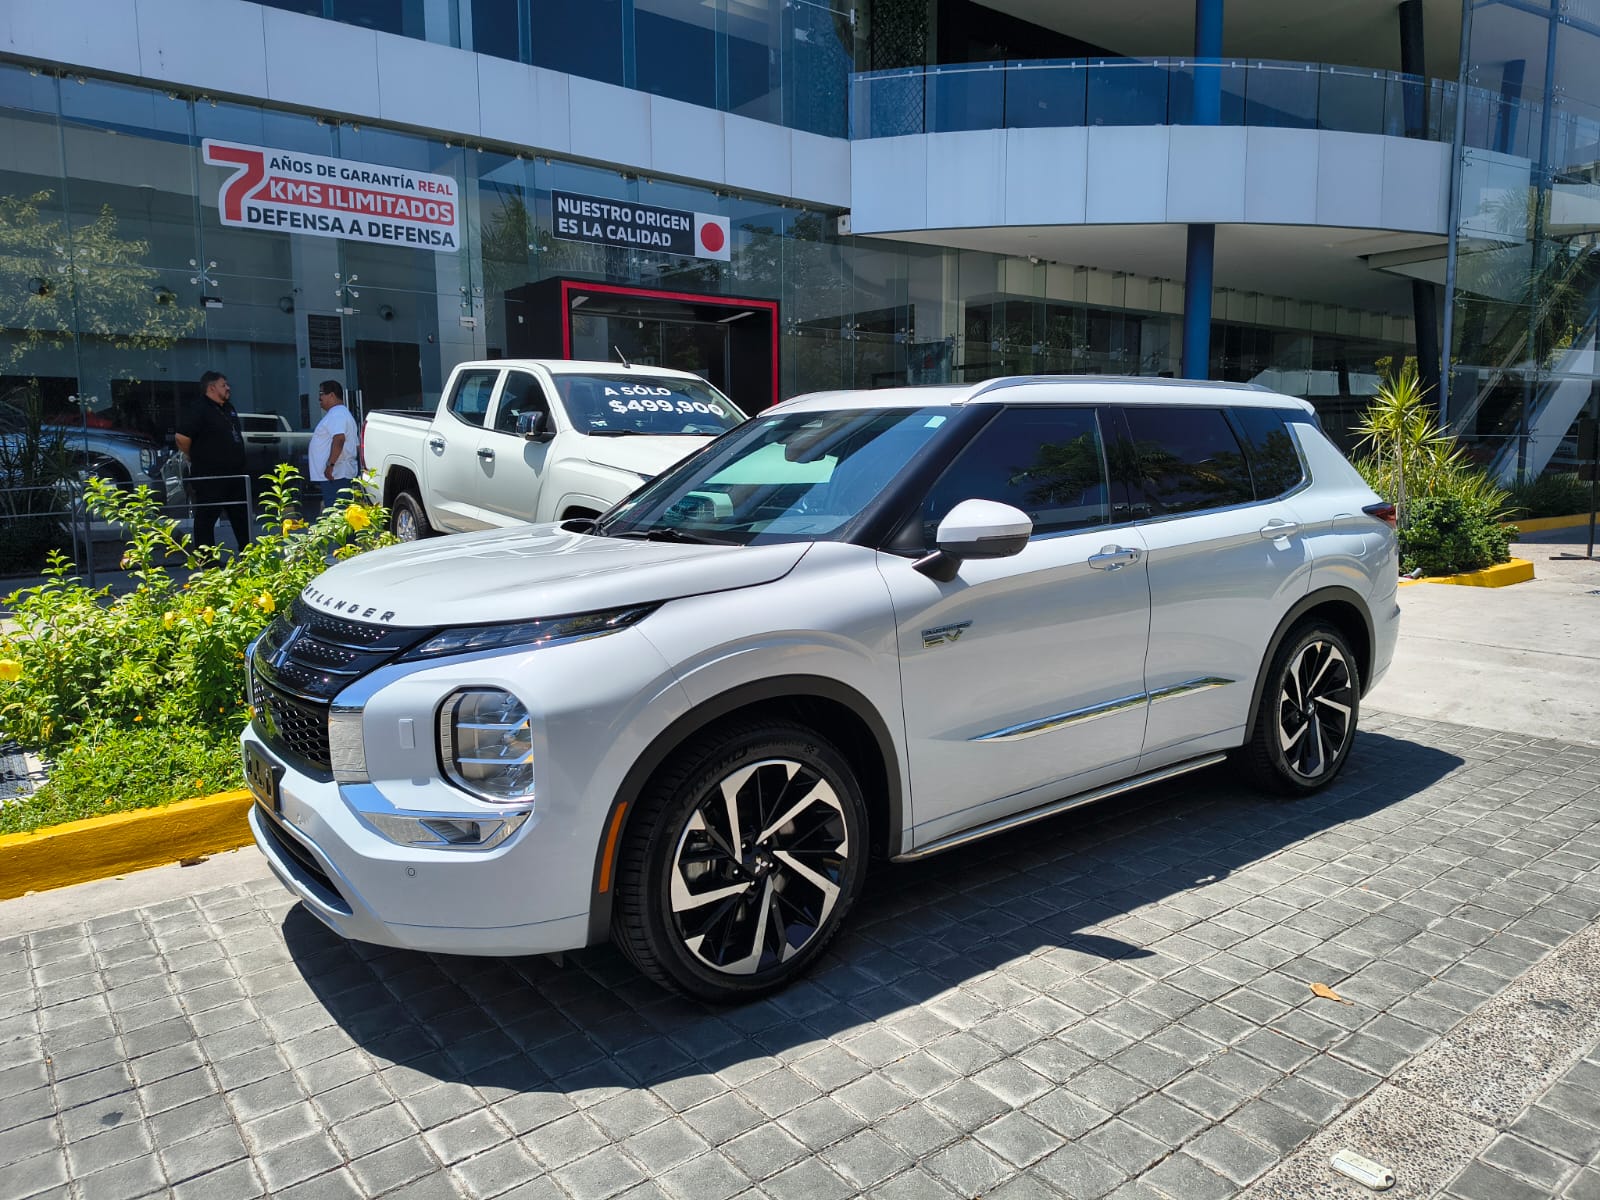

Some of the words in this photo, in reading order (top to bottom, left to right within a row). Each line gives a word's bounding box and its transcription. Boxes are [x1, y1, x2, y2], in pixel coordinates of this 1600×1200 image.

[208, 144, 265, 221] 7
[269, 155, 313, 174] AÑOS
[317, 164, 337, 178] DE
[340, 168, 415, 190] GARANTÍA
[418, 180, 453, 196] REAL
[270, 179, 322, 204] KMS
[328, 188, 452, 222] ILIMITADOS
[557, 197, 632, 223] NUESTRO
[635, 210, 690, 232] ORIGEN
[247, 206, 345, 234] DEFENSA
[349, 218, 366, 236] A
[368, 222, 455, 248] DEFENSA
[558, 217, 578, 234] ES
[582, 221, 603, 239] LA
[606, 225, 672, 247] CALIDAD
[604, 387, 620, 396] A
[620, 384, 672, 396] SÓLO
[608, 399, 725, 416] $499,900
